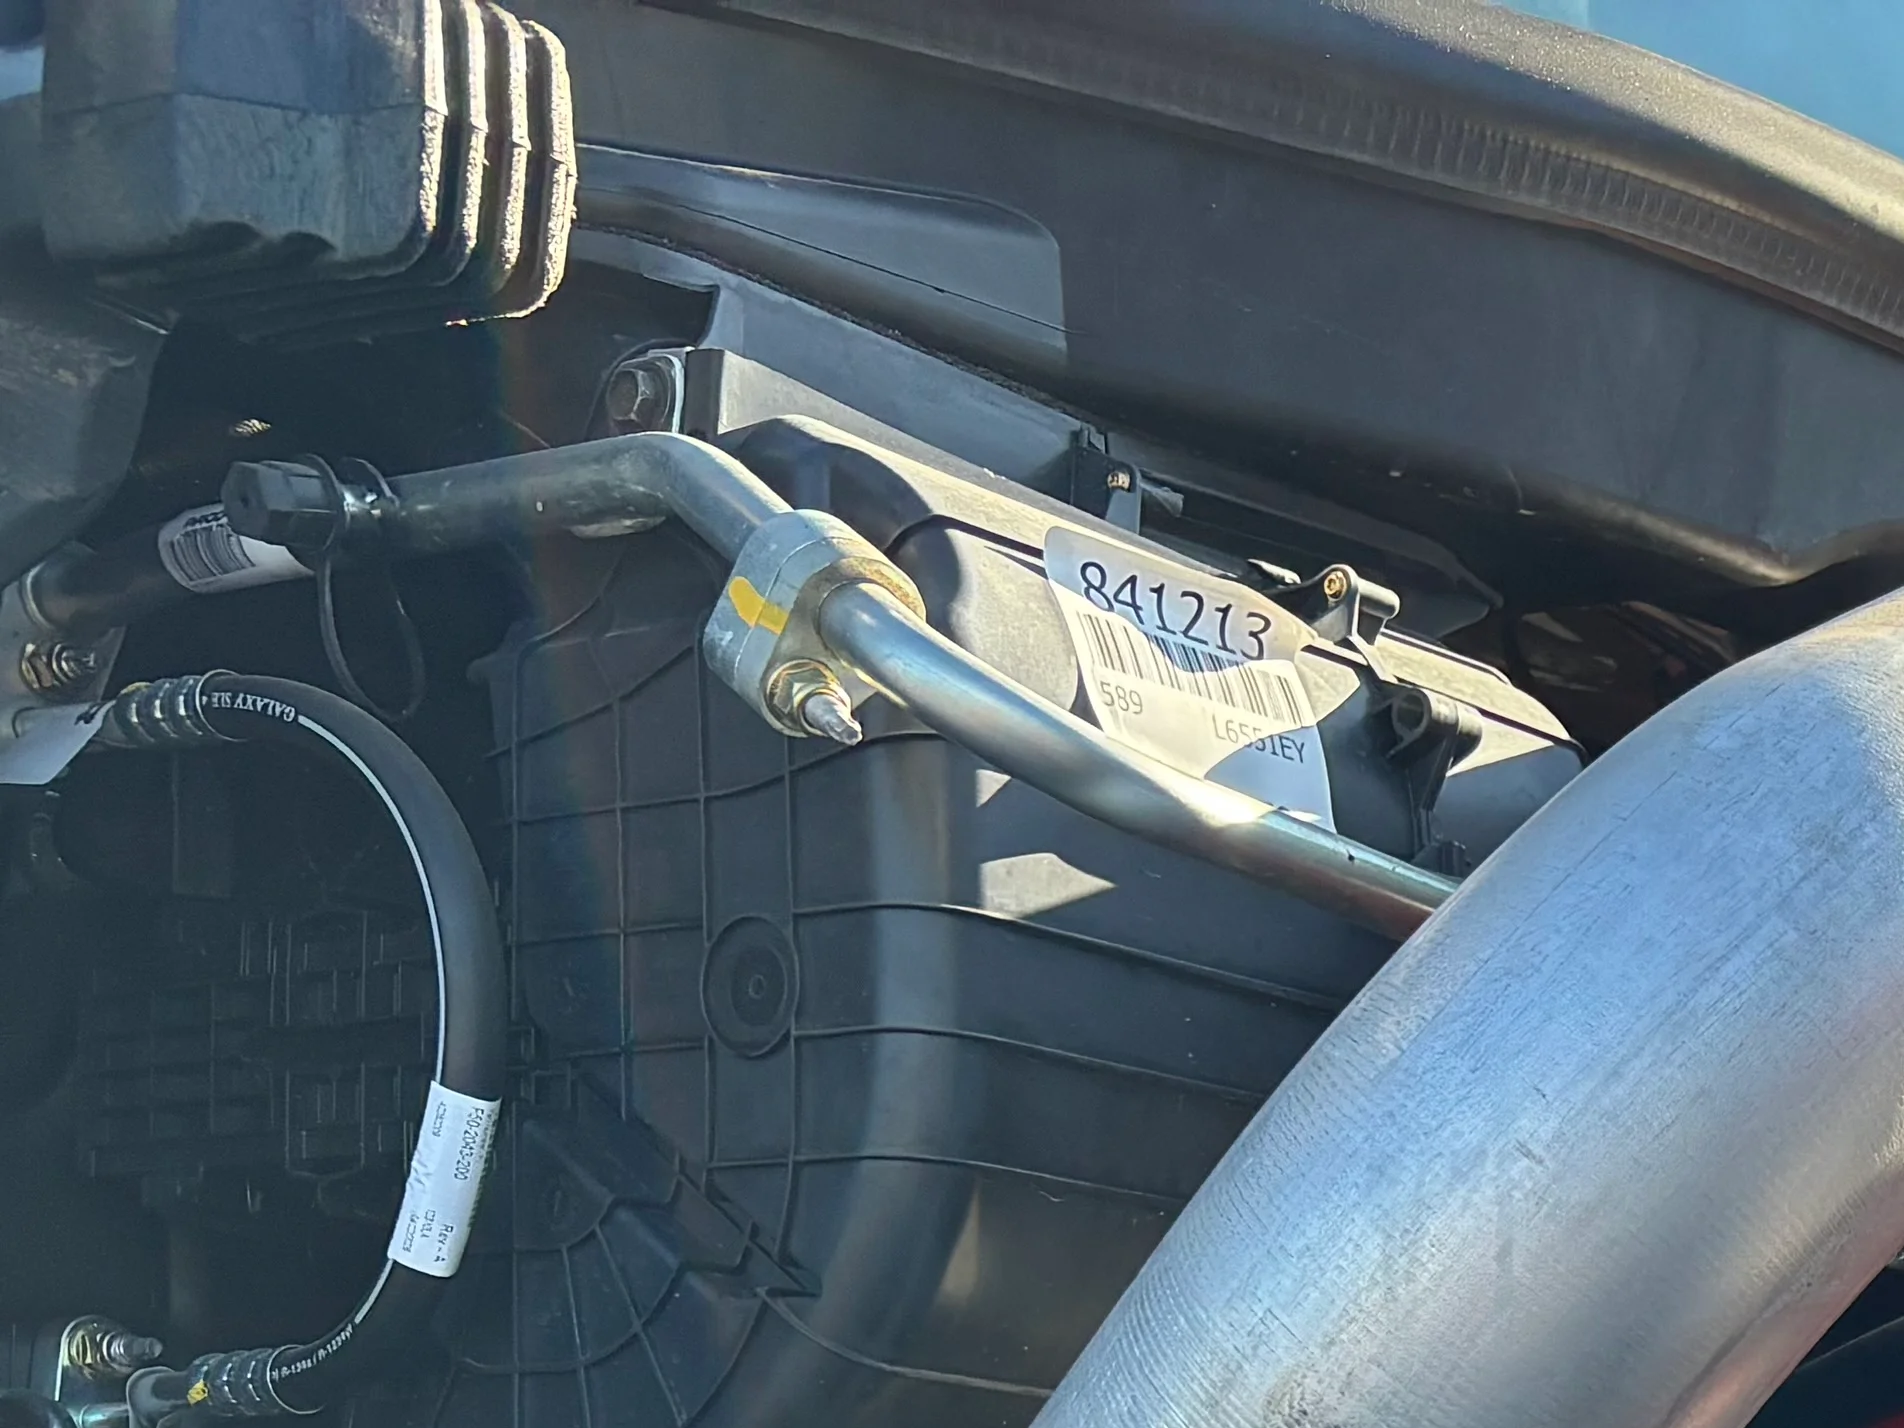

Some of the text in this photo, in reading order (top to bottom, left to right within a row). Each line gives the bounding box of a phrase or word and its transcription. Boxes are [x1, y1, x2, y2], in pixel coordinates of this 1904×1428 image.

[1080, 561, 1272, 661] 841213
[211, 692, 296, 722] GALAXY SLE
[1100, 680, 1144, 715] 589
